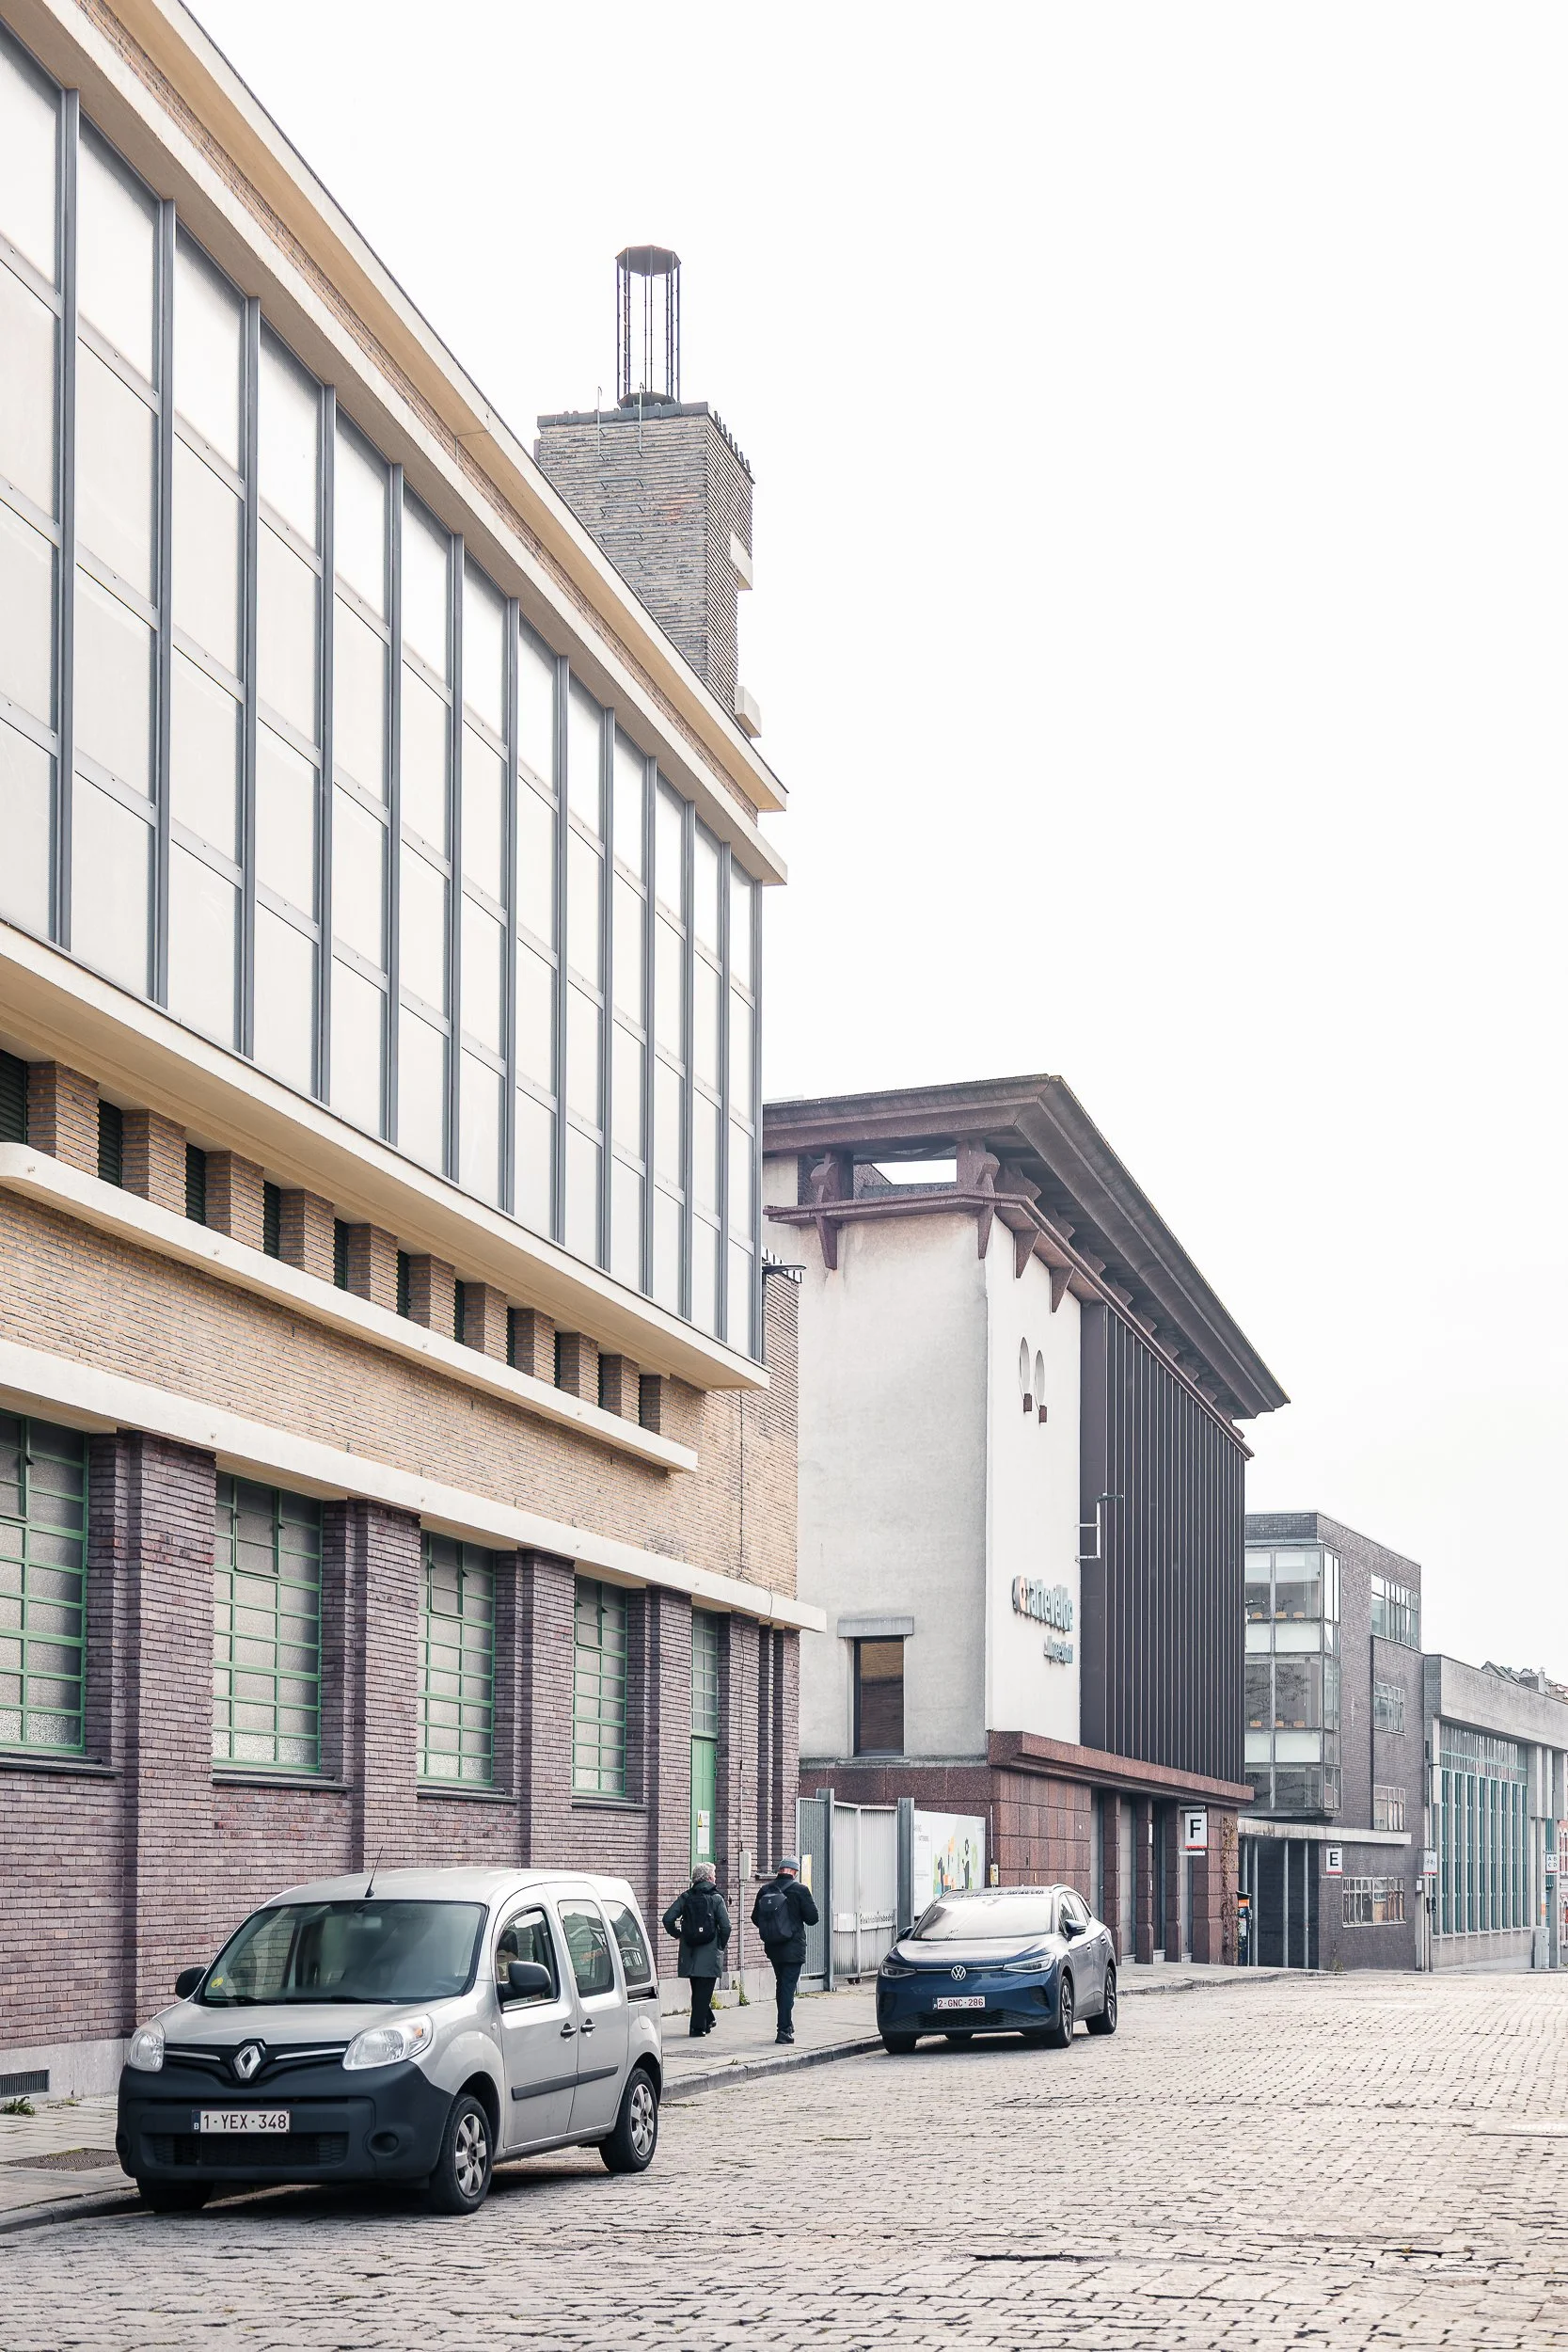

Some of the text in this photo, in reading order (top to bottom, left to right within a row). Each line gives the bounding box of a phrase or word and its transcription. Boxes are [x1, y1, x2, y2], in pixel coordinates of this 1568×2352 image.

[1190, 1819, 1202, 1838] F
[1329, 1851, 1339, 1867] E
[203, 2114, 287, 2130] 1-YEX-348
